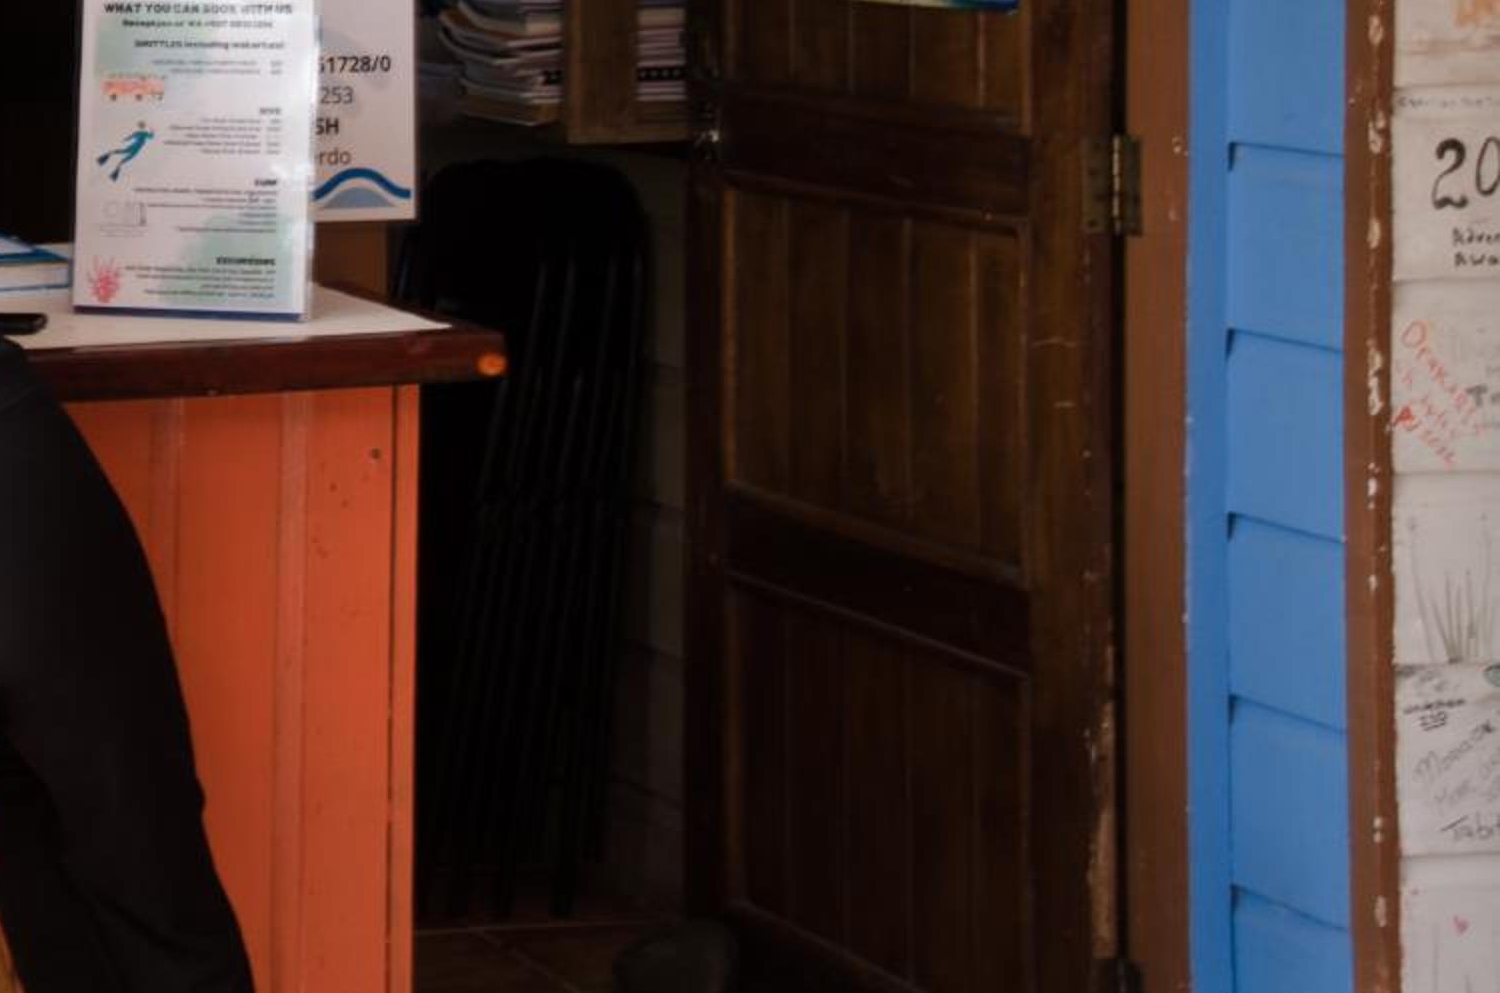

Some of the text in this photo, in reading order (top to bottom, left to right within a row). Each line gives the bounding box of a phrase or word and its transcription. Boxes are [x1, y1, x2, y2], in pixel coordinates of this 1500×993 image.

[104, 4, 140, 14] WHAT
[145, 4, 171, 14] YOU
[173, 4, 200, 14] CAN
[202, 4, 237, 15] BOOK
